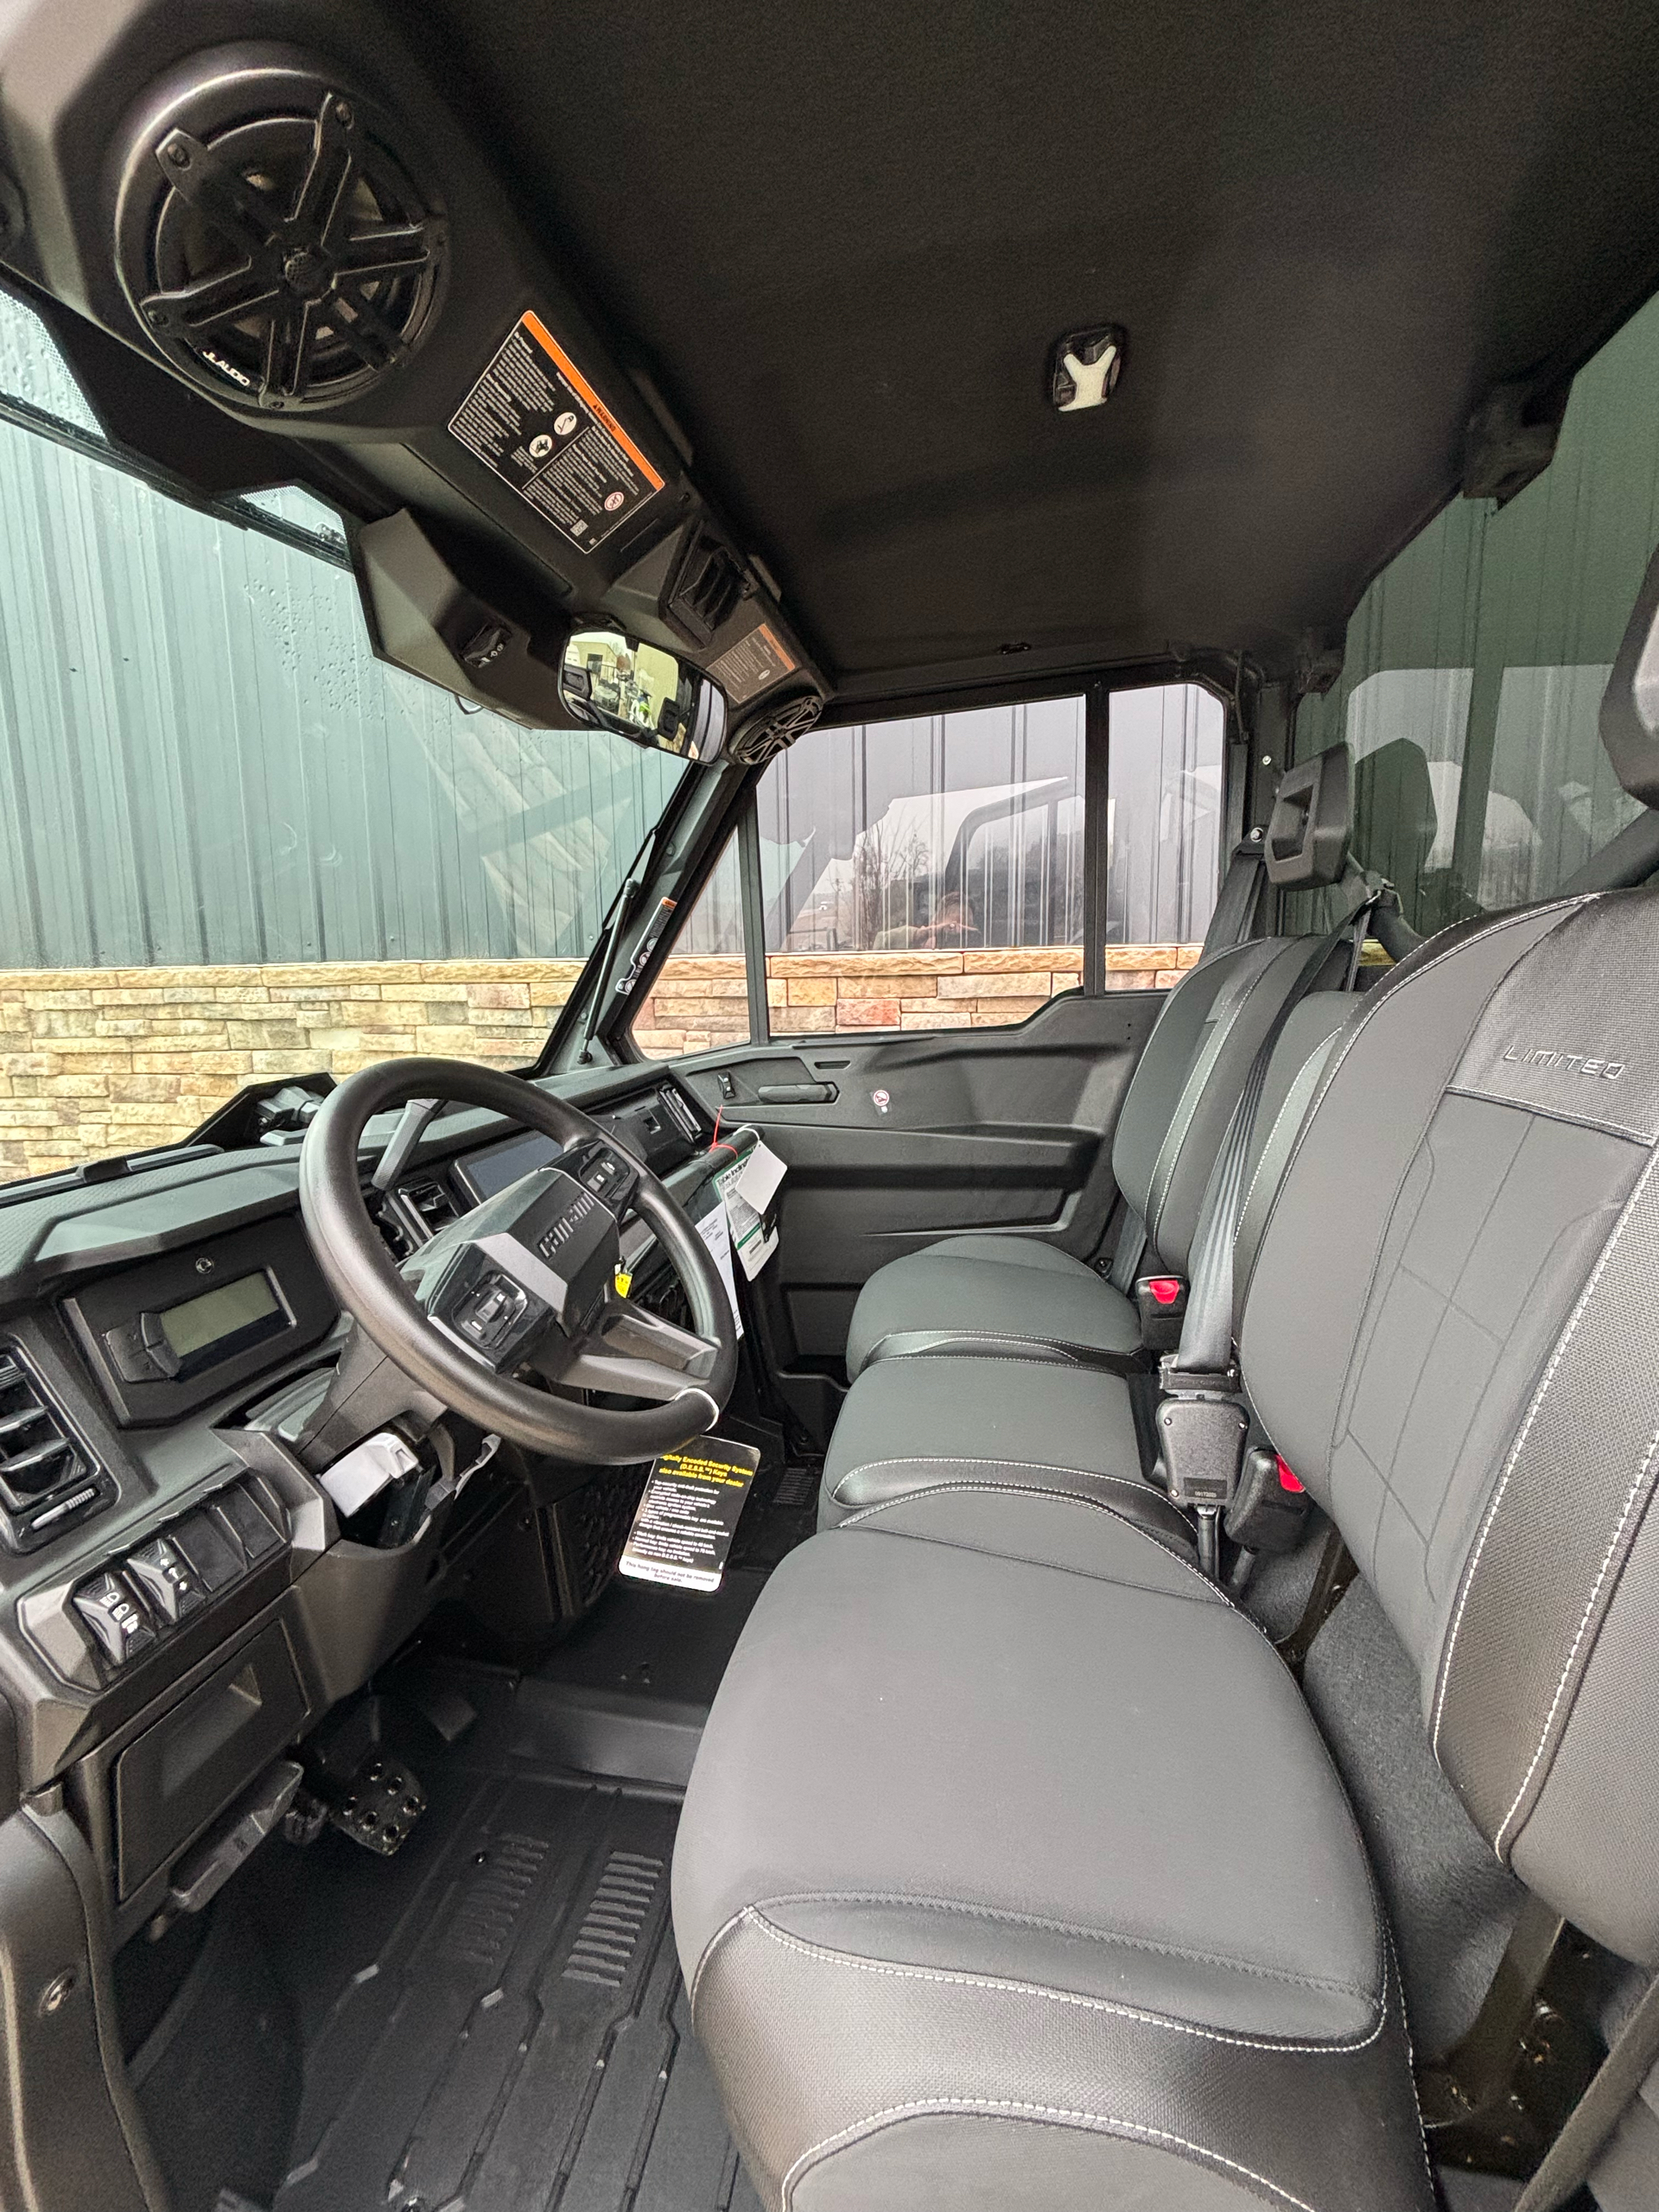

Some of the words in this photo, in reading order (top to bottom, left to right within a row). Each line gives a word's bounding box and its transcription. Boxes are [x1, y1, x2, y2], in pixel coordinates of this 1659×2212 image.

[215, 359, 251, 386] AUDIO
[595, 406, 616, 431] WARNING
[1503, 1045, 1625, 1079] LIMITED
[682, 1455, 708, 1466] Encoded
[707, 1459, 732, 1471] Security
[730, 1465, 753, 1476] System
[711, 1469, 728, 1478] Keys
[671, 1468, 697, 1479] available
[696, 1472, 712, 1482] from
[710, 1476, 726, 1484] your
[725, 1478, 744, 1488] dealer
[693, 1573, 714, 1583] removed
